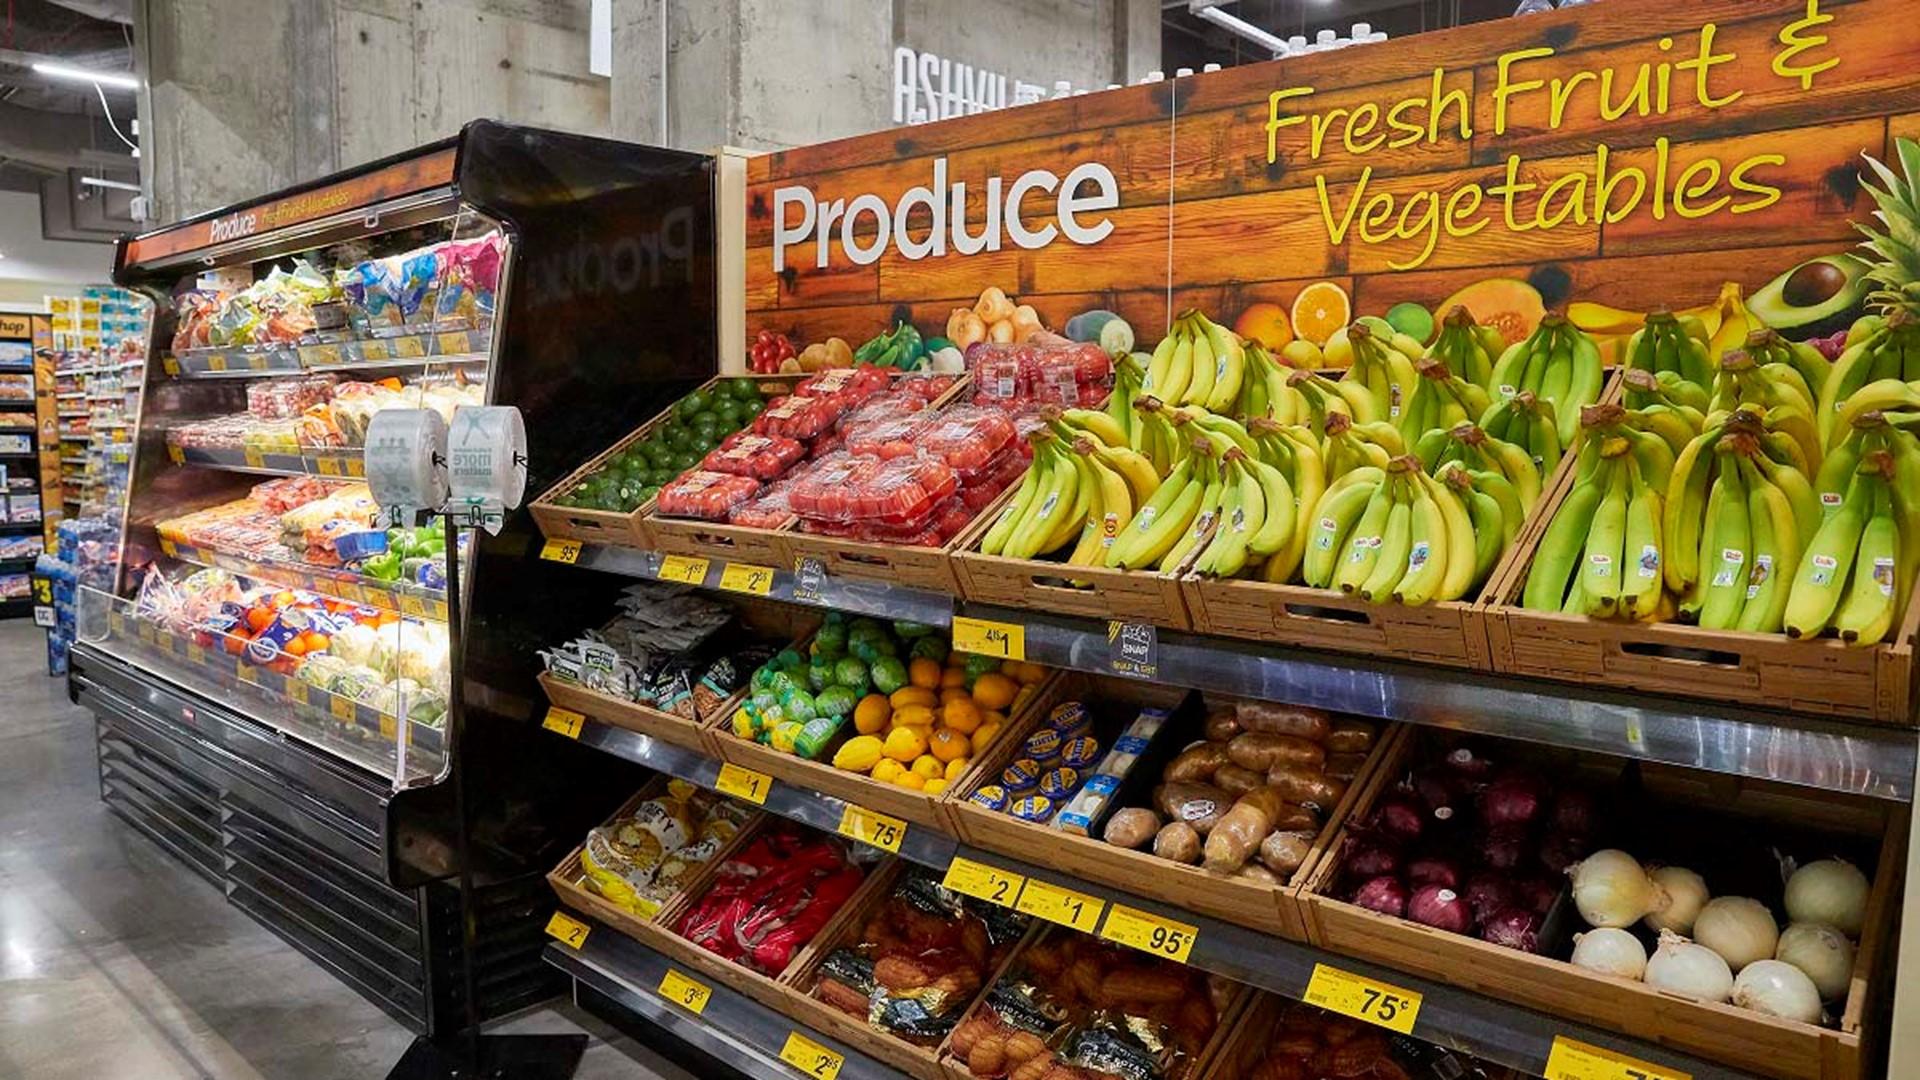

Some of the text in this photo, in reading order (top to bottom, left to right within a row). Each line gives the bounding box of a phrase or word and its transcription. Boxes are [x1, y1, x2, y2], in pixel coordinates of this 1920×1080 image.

[1265, 0, 1840, 164] Fresh Fruit &
[209, 212, 257, 243] Produce
[773, 157, 1120, 273] Produce
[1315, 136, 1786, 271] Vegetables
[1360, 988, 1409, 1021] 75¢
